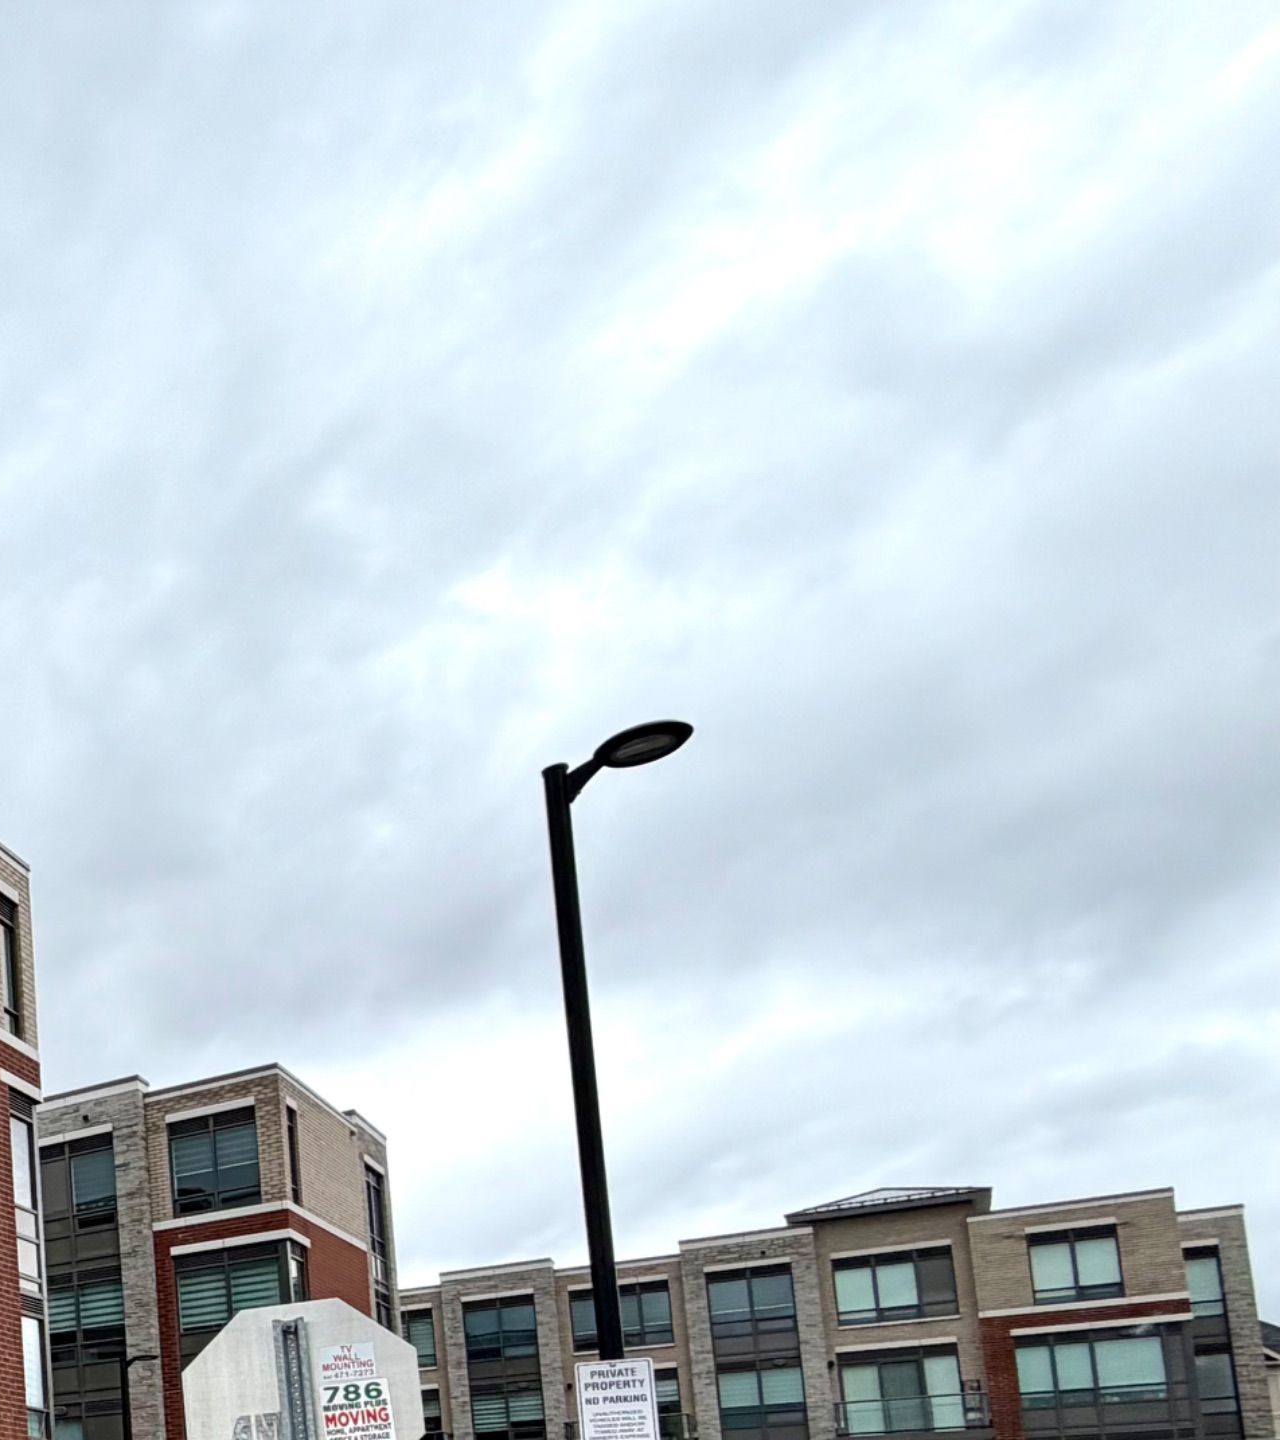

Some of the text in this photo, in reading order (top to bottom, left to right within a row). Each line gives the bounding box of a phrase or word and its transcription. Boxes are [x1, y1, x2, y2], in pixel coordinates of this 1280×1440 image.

[340, 1345, 352, 1353] TV
[333, 1352, 360, 1362] WALL
[322, 1359, 374, 1372] MOUNTING
[590, 1367, 637, 1379] PRIVATE
[584, 1378, 645, 1391] PROPERTY
[323, 1382, 383, 1404] 786
[323, 1399, 388, 1412] MOVING PLUS
[585, 1394, 648, 1405] NO PARKING
[325, 1407, 390, 1428] MOVING
[360, 1432, 390, 1440] STORAGE
